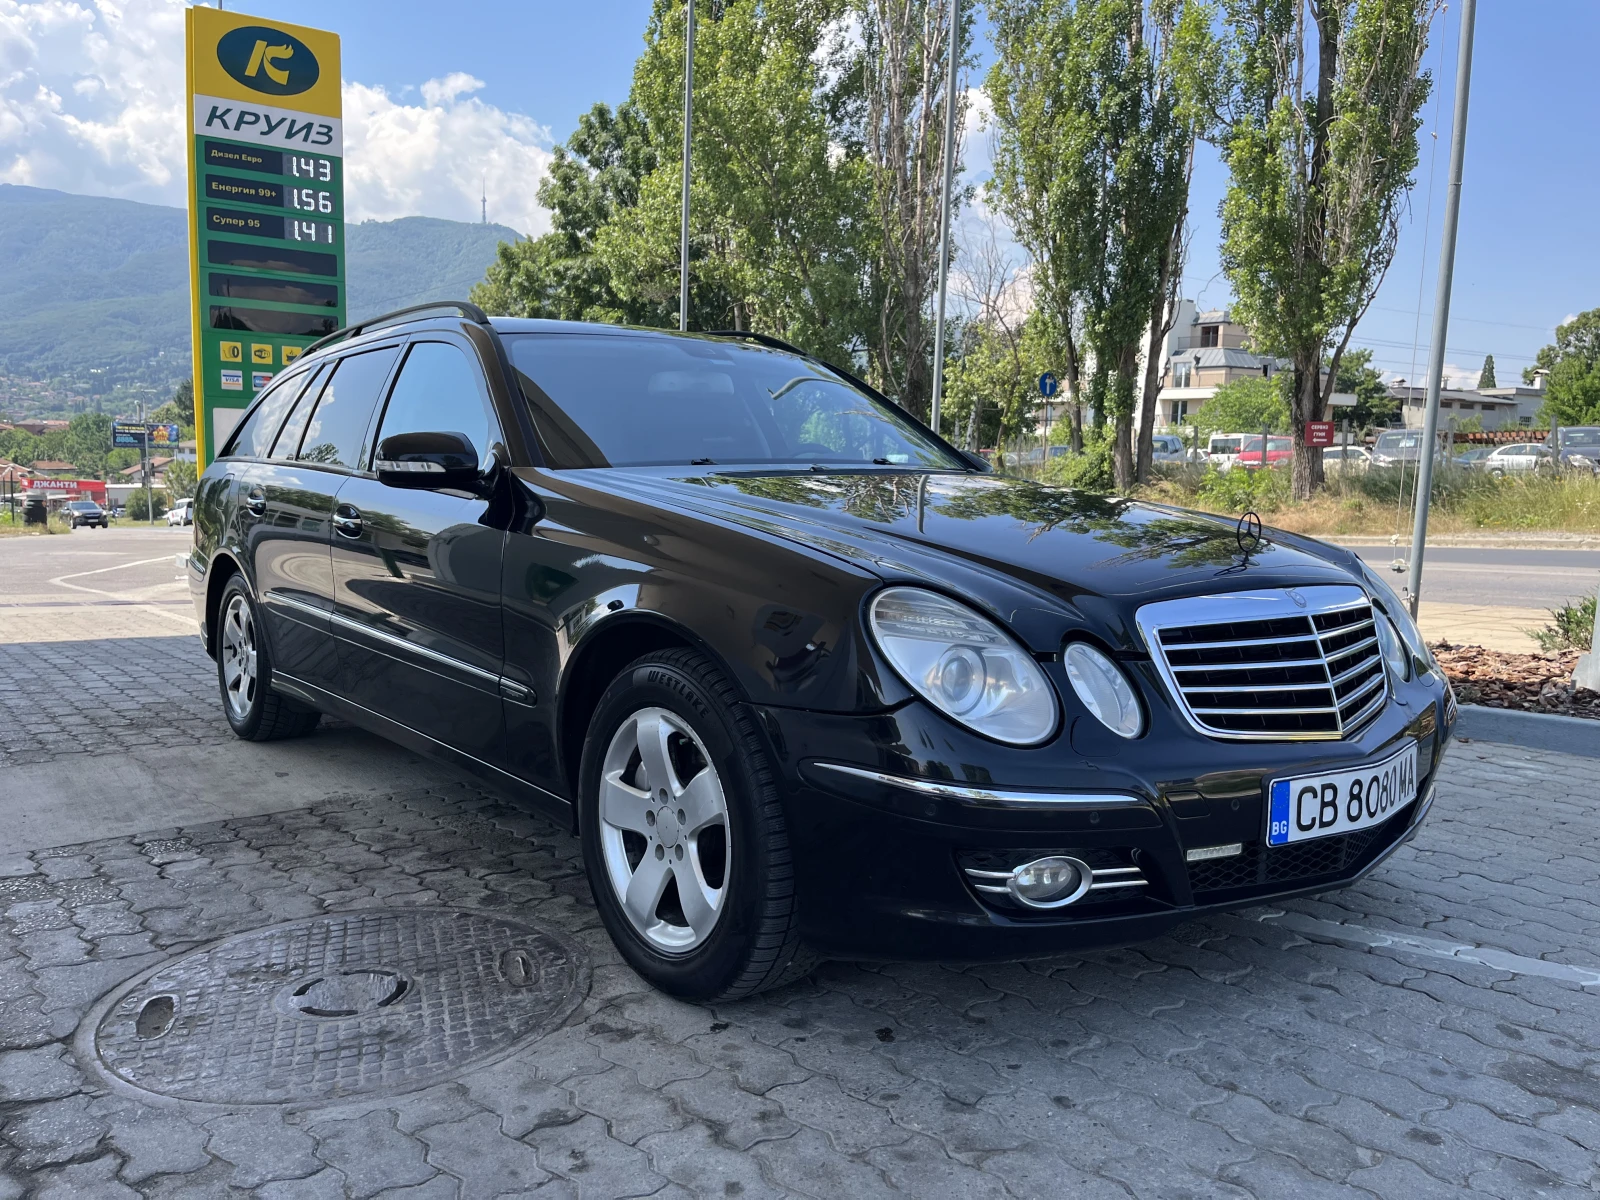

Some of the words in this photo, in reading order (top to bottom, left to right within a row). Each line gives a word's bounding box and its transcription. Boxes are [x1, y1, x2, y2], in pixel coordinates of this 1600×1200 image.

[205, 106, 333, 145] КРУИЗ
[211, 150, 239, 160] Дизел
[242, 154, 262, 163] Евро
[292, 156, 331, 182] 1.43
[212, 182, 255, 194] Енергия
[258, 188, 276, 197] 99+
[293, 188, 332, 213] 1.56
[213, 215, 245, 227] Супер
[248, 219, 260, 228] 95
[294, 220, 333, 244] 1.41
[32, 480, 77, 489] ДЖАНТИ
[647, 670, 710, 718] WESTLAKE
[1296, 783, 1338, 832] CB
[1346, 765, 1397, 823] 8080
[1271, 821, 1288, 836] BG
